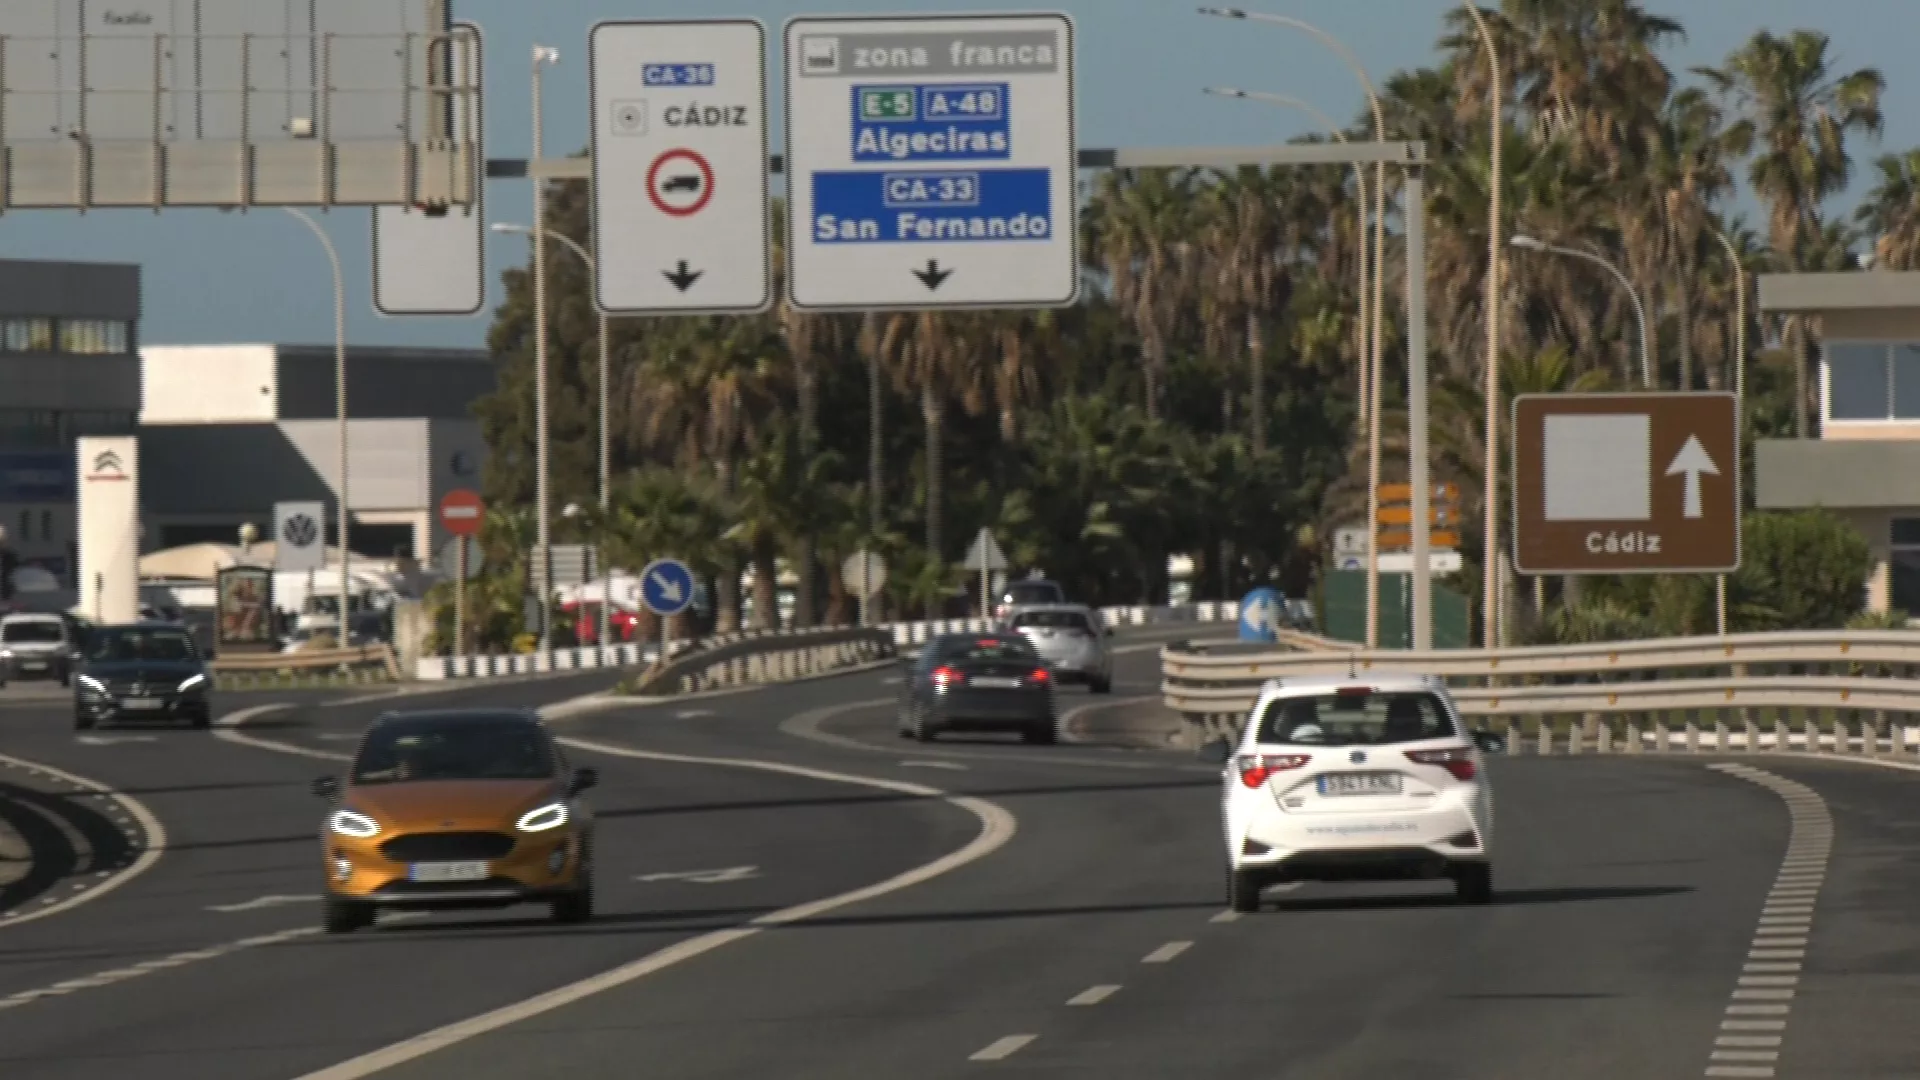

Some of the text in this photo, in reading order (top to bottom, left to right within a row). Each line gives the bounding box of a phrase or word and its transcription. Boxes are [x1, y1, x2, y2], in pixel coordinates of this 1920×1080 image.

[854, 39, 1055, 68] zona franca
[646, 65, 712, 84] CA-36
[662, 101, 748, 126] CÁDIZ
[866, 91, 996, 116] E-5 A-48
[856, 126, 1007, 158] Algeciras
[889, 179, 973, 200] CA-33
[815, 212, 1048, 240] San Fernando
[1585, 530, 1661, 554] Cádiz
